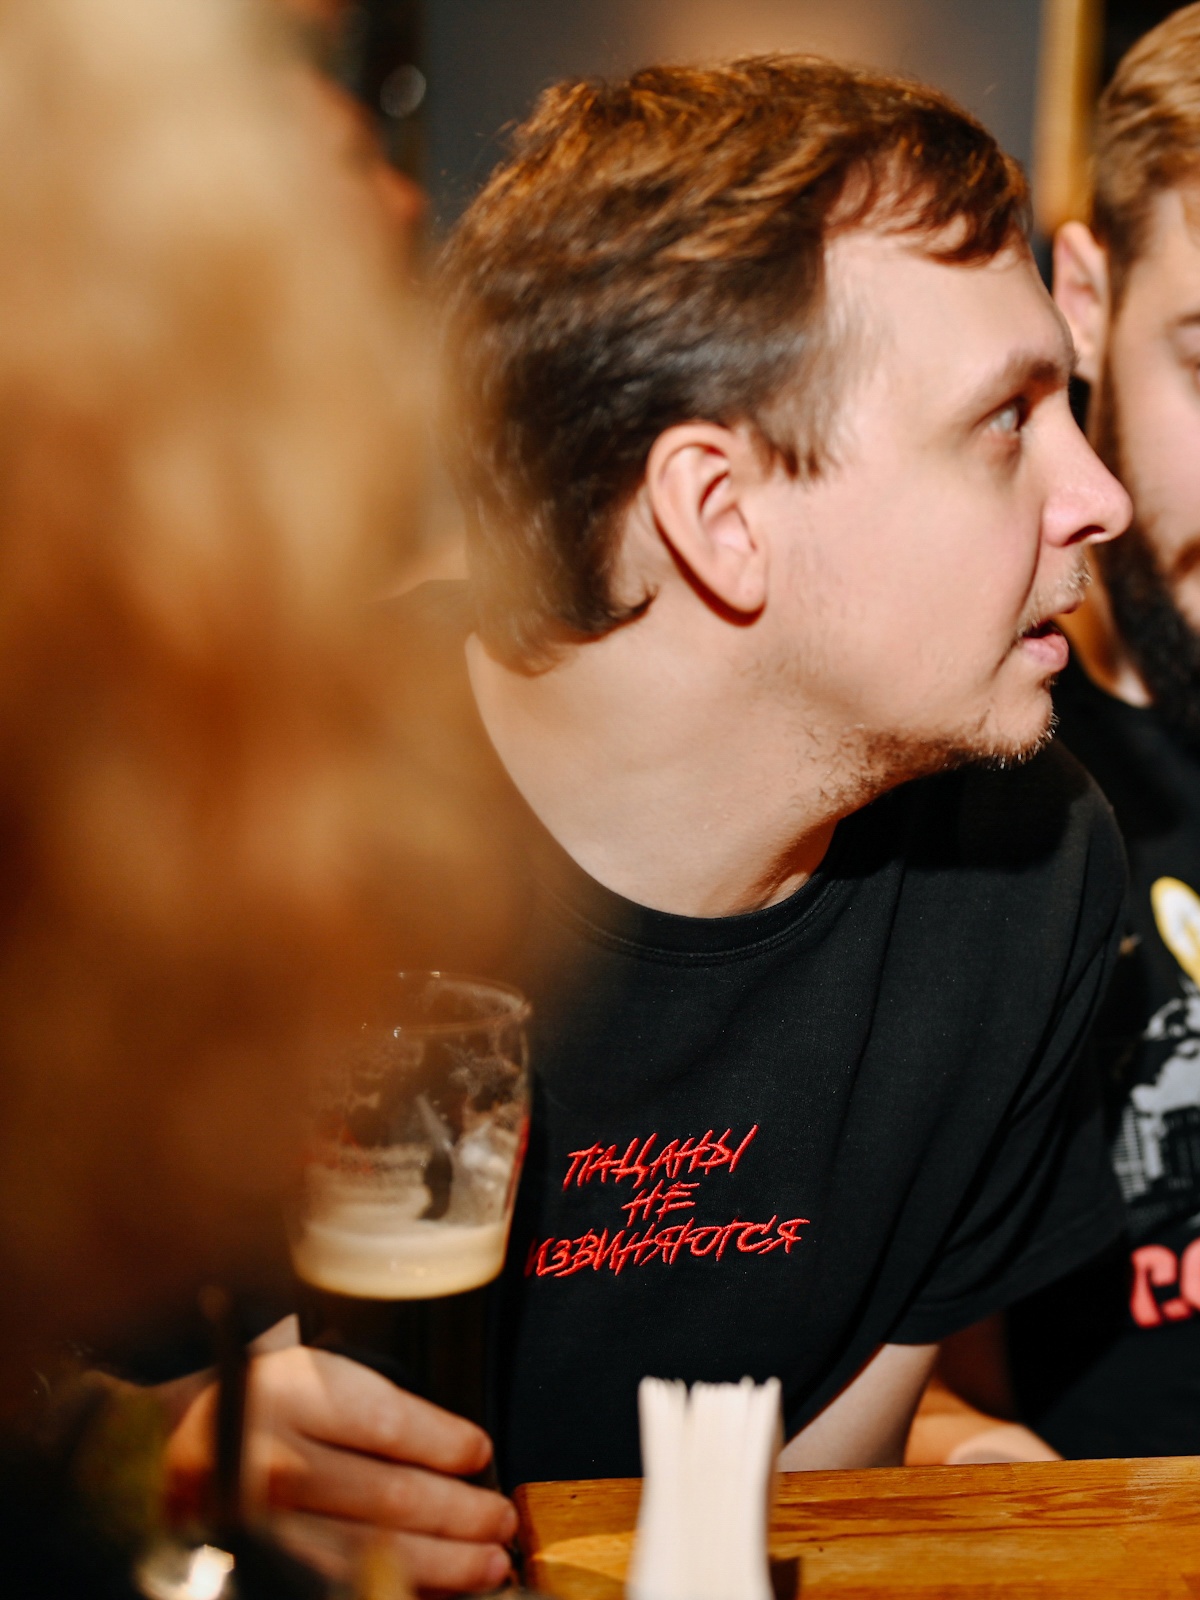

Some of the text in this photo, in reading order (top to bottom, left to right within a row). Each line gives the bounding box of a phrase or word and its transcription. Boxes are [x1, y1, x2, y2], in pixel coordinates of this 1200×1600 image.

[562, 1124, 759, 1192] ПАЦАНЫ
[621, 1178, 700, 1228] НЕ
[524, 1214, 811, 1278] ИЗВИНЯЮТСЯ
